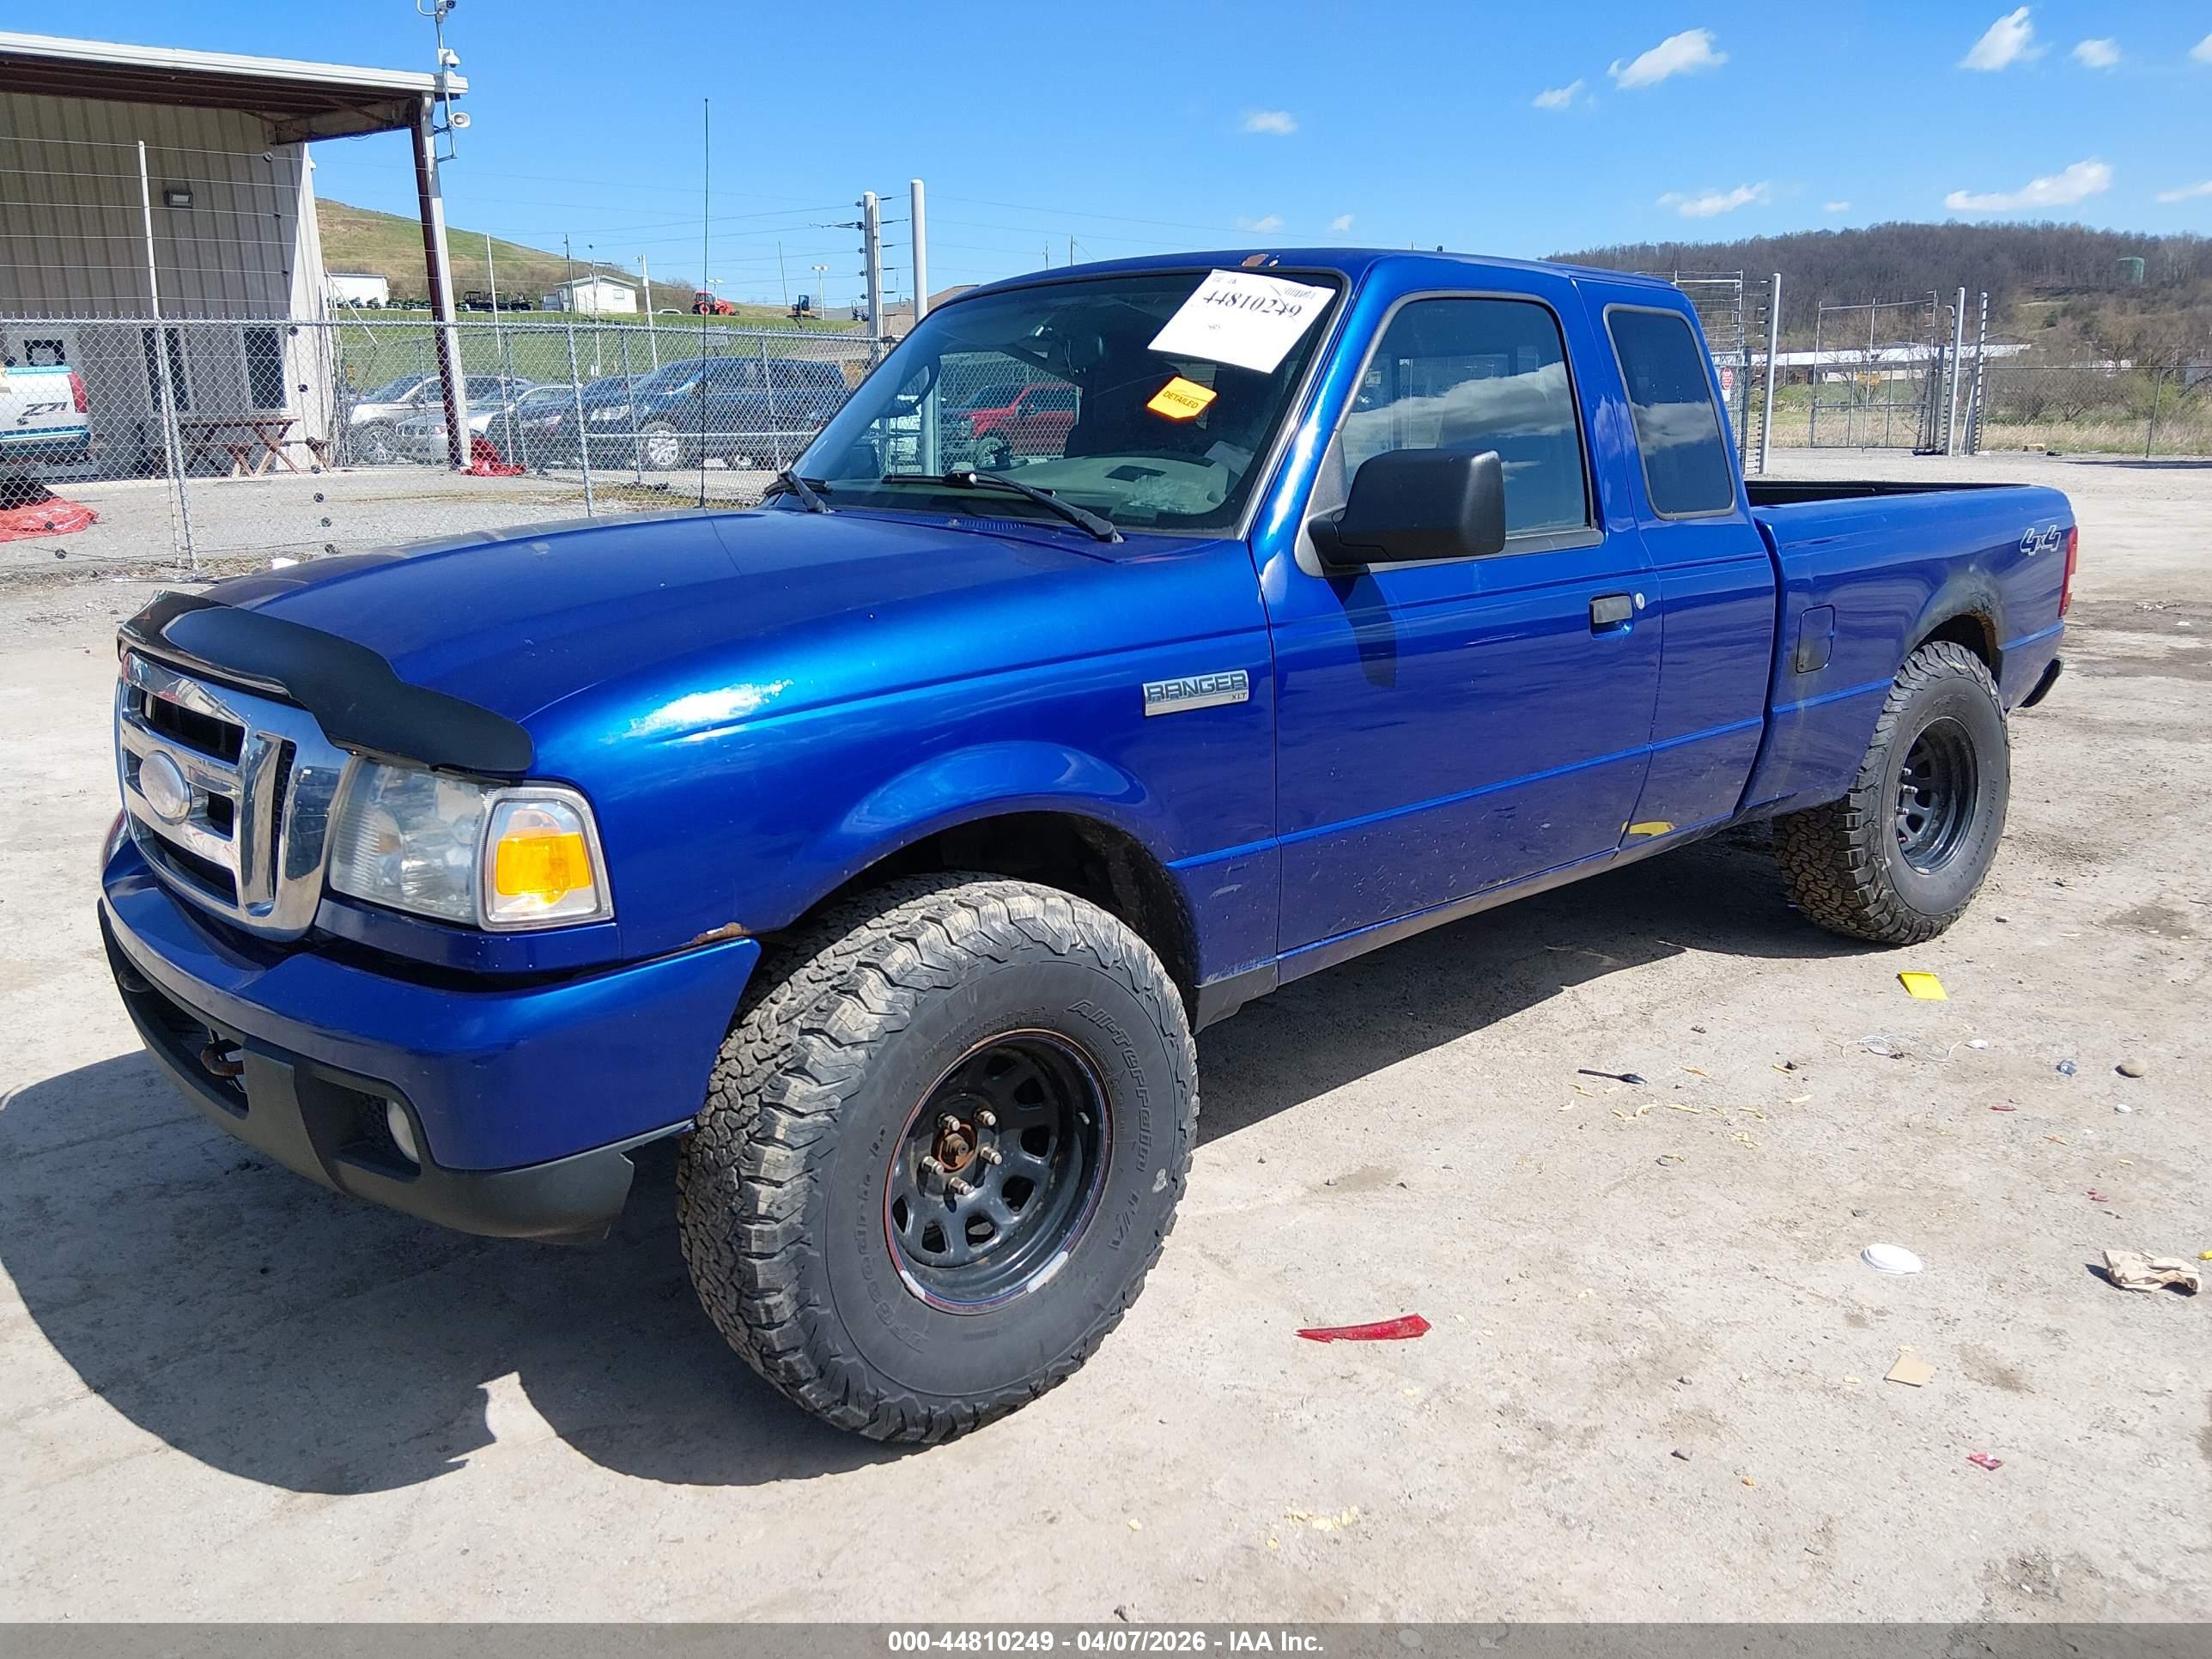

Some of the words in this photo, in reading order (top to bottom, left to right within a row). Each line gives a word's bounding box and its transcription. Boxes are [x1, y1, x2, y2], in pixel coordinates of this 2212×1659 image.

[1203, 290, 1303, 317] 44810249
[21, 401, 68, 417] Z71
[1163, 391, 1199, 409] DETAILED
[2020, 525, 2061, 556] 4x4
[1146, 672, 1248, 703] RANGER
[1067, 1000, 1152, 1172] All-Terrain
